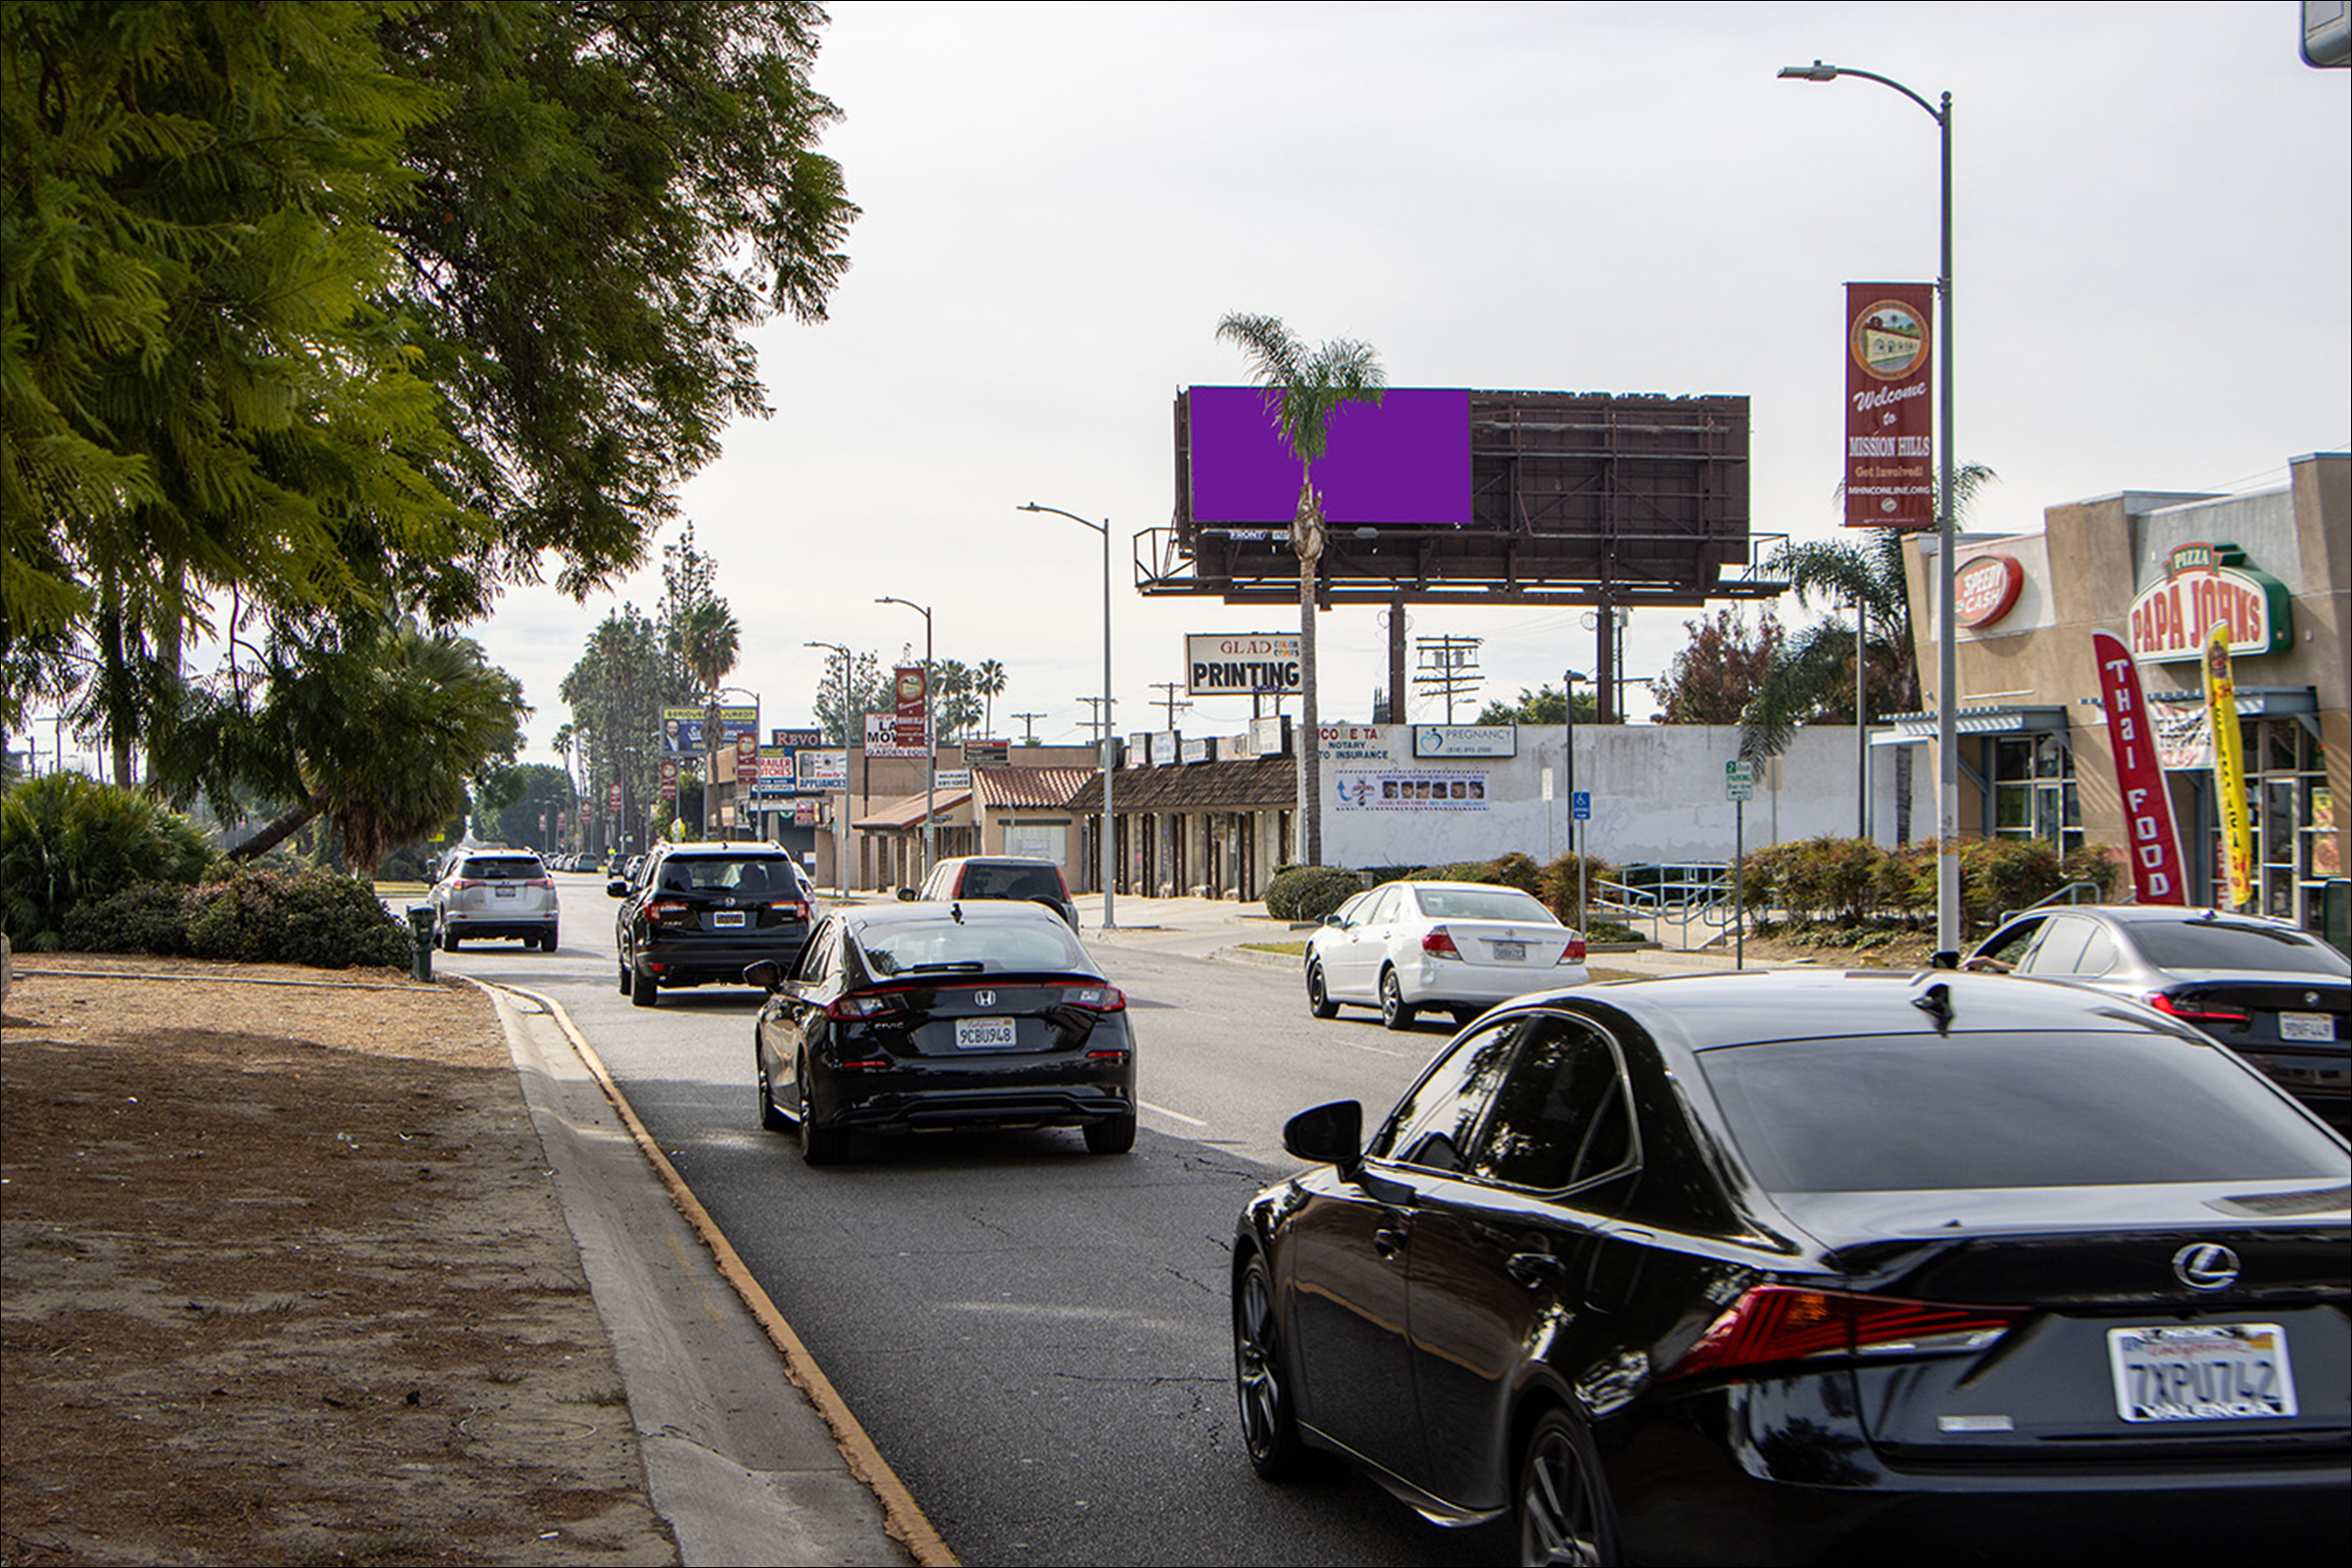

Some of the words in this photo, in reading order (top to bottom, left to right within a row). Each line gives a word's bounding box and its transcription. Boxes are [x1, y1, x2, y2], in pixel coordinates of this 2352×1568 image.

[1852, 381, 1928, 412] Welcome
[1882, 412, 1897, 425] to
[1849, 437, 1895, 458] MISSION
[1898, 437, 1931, 458] HILLS
[1855, 466, 1873, 478] Get
[1876, 465, 1924, 478] Involved!
[2174, 549, 2210, 570] PIZZA
[1965, 587, 2002, 614] CASH
[2132, 583, 2186, 654] PAPA
[1220, 641, 1272, 655] GLAD
[1193, 662, 1299, 687] PRINTING
[1446, 728, 1511, 739] PREGNANCY
[1336, 750, 1389, 760] INSURANCE
[758, 767, 792, 776] ITCHES
[2128, 788, 2170, 897] FOOD
[960, 1028, 1010, 1045] 9CBU948
[2128, 1359, 2280, 1404] 7XPU742
